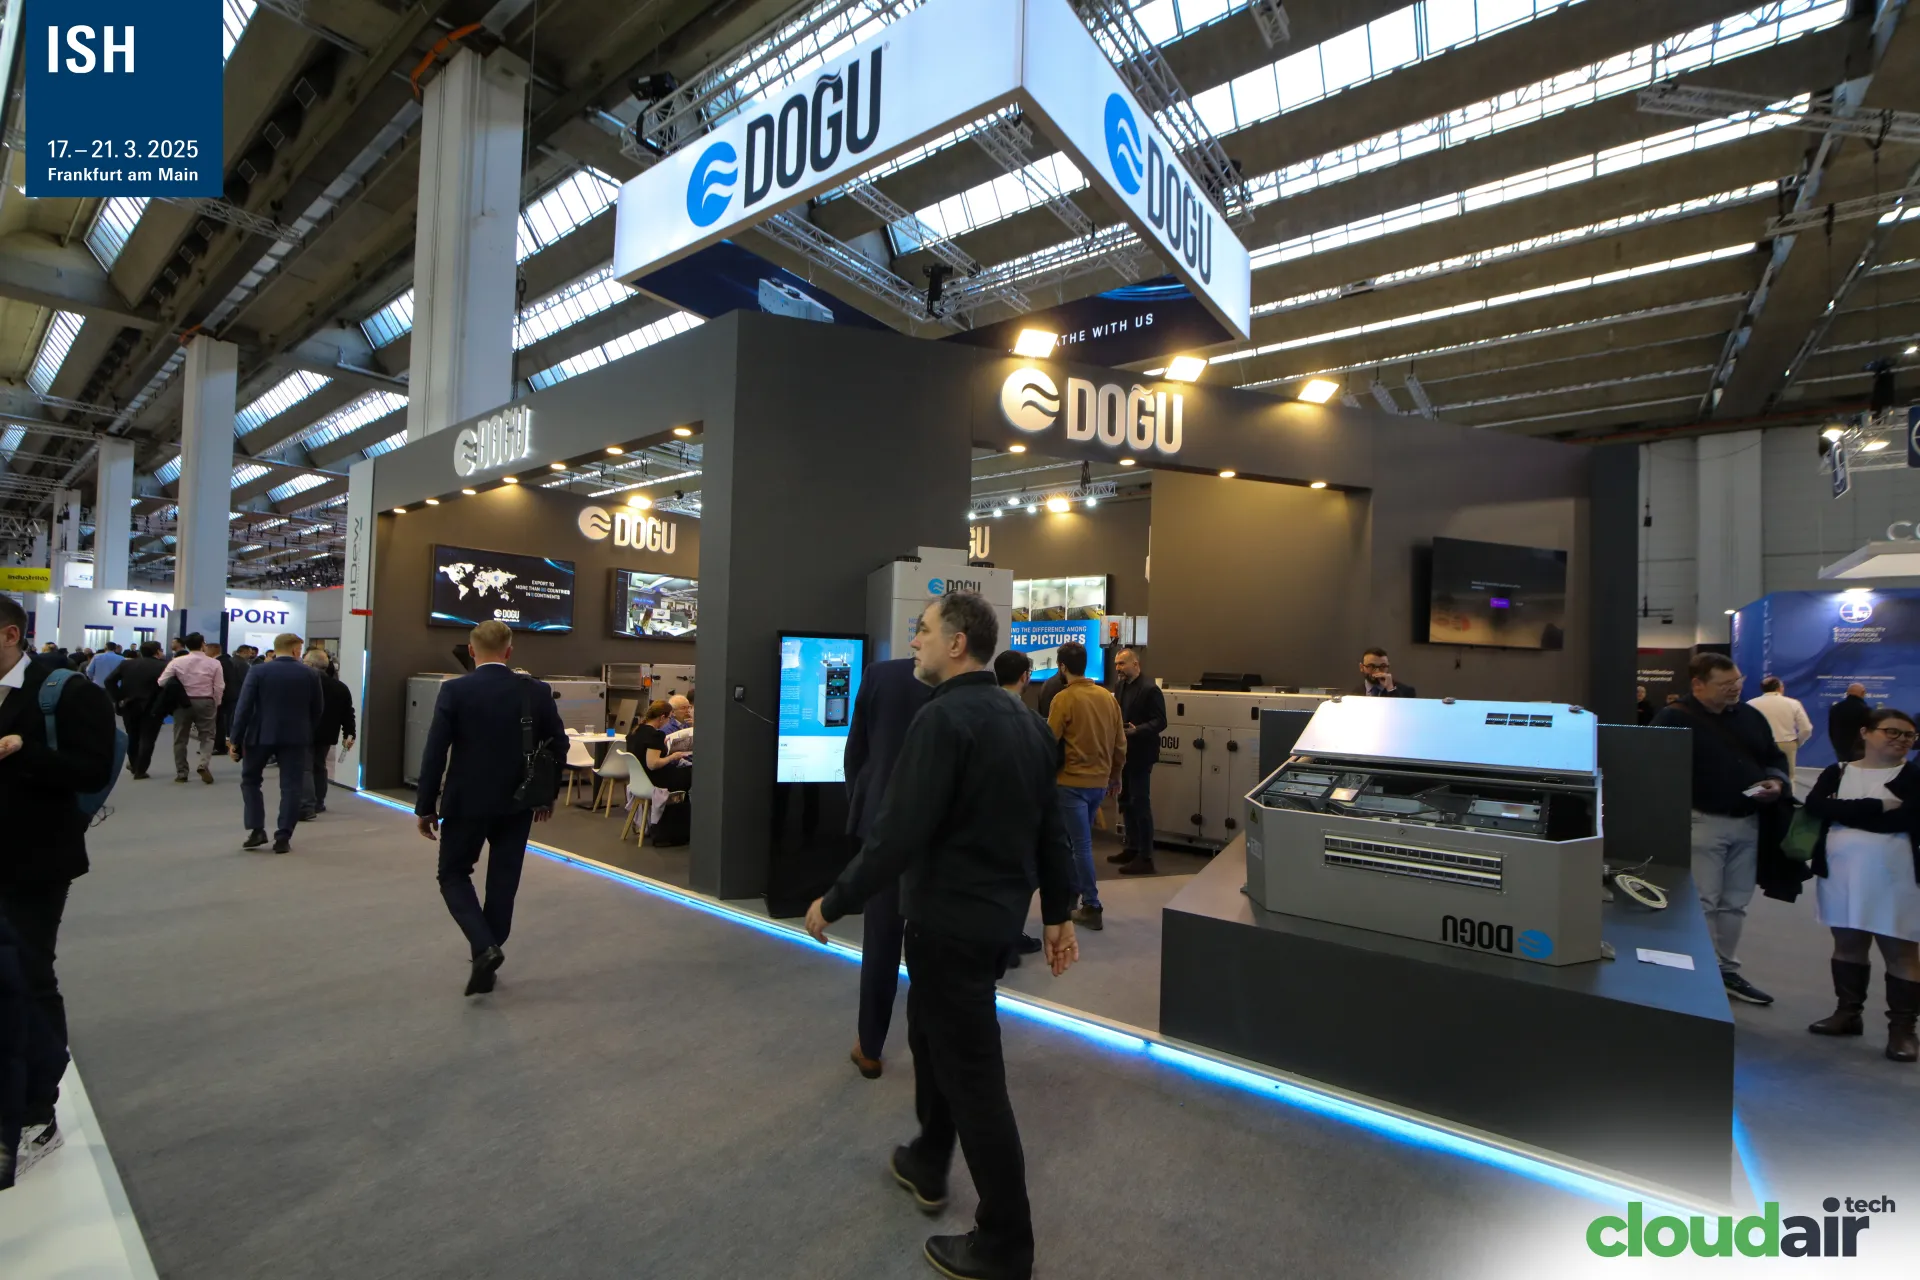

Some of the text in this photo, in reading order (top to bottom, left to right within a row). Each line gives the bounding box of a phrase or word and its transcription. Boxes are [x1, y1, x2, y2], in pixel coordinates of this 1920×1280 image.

[1092, 319, 1127, 339] WITH
[1135, 313, 1154, 328] US
[1031, 633, 1086, 645] PICTURES
